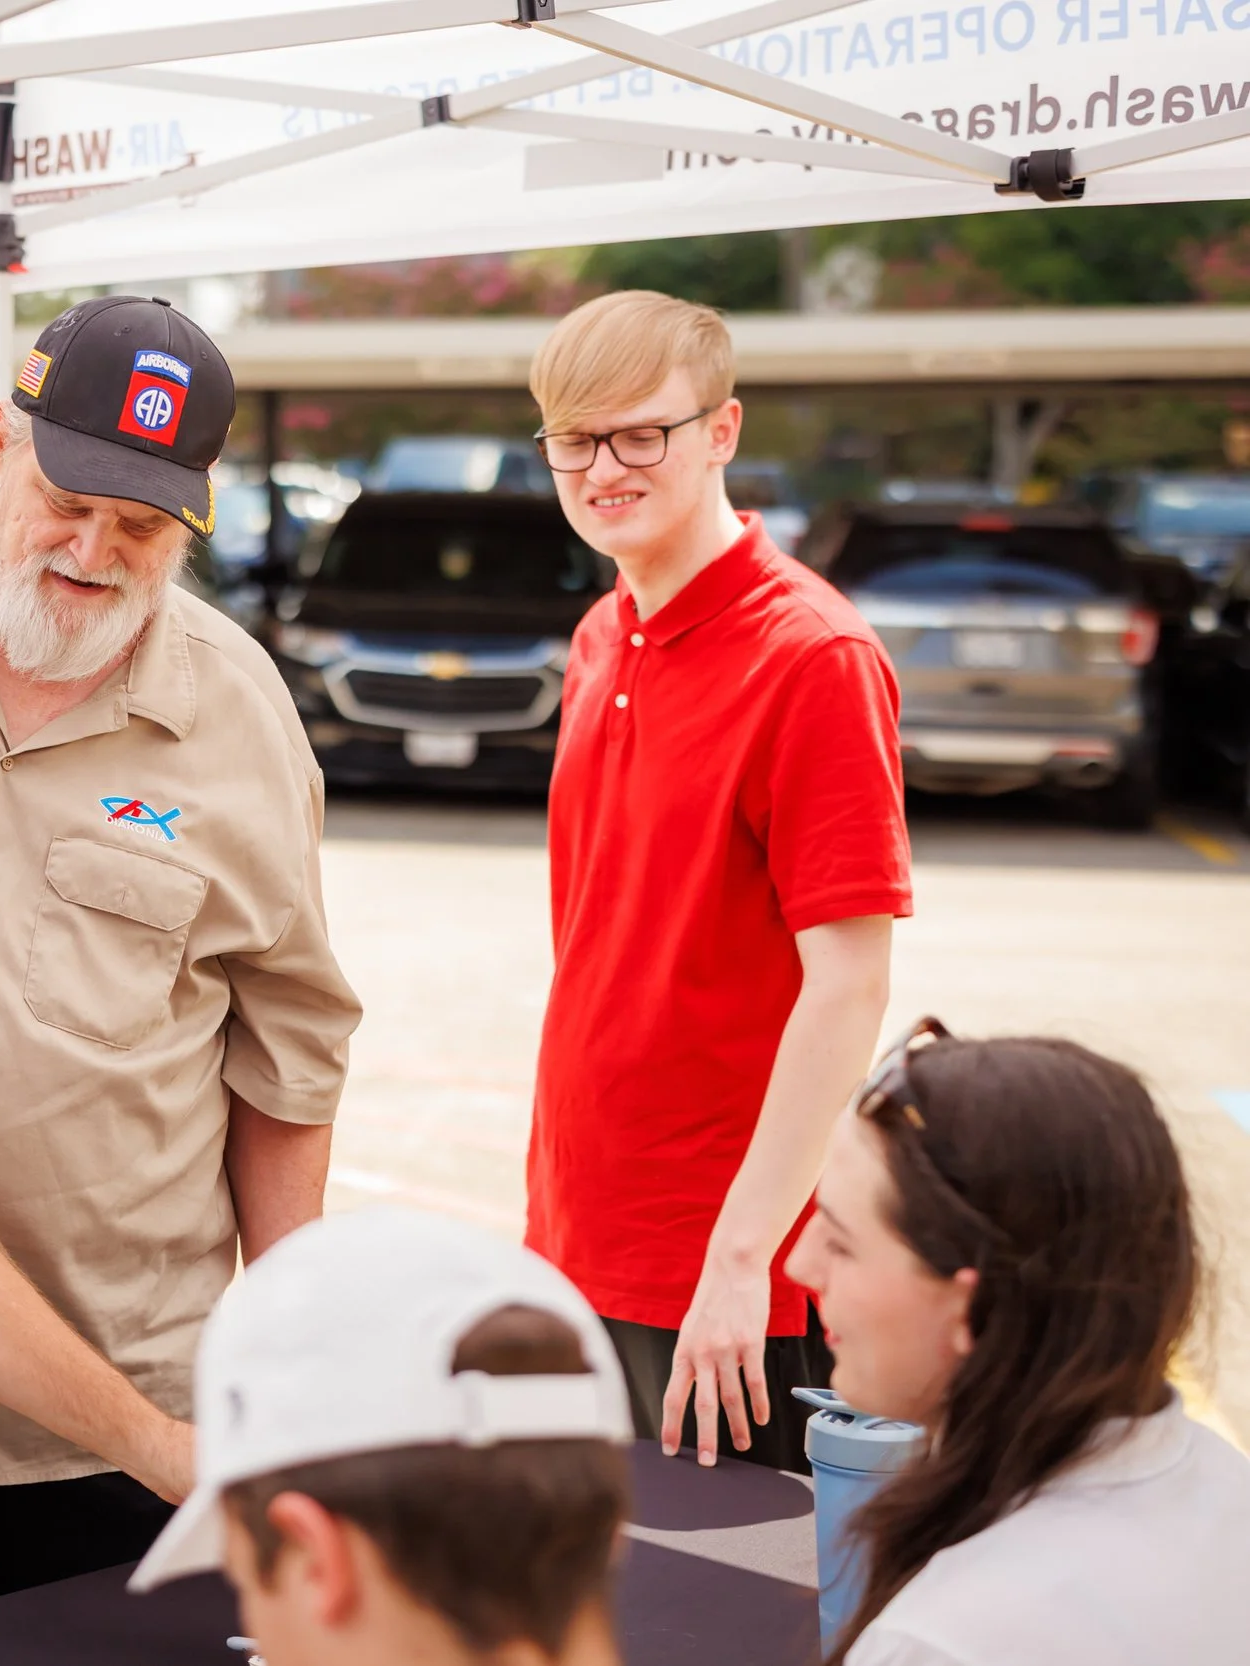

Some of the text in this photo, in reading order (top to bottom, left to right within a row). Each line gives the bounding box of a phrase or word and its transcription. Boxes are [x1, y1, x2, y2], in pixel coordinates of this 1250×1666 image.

[137, 353, 189, 383] AIRBORNE
[135, 389, 172, 428] AA
[105, 815, 167, 843] DIAKONIA
